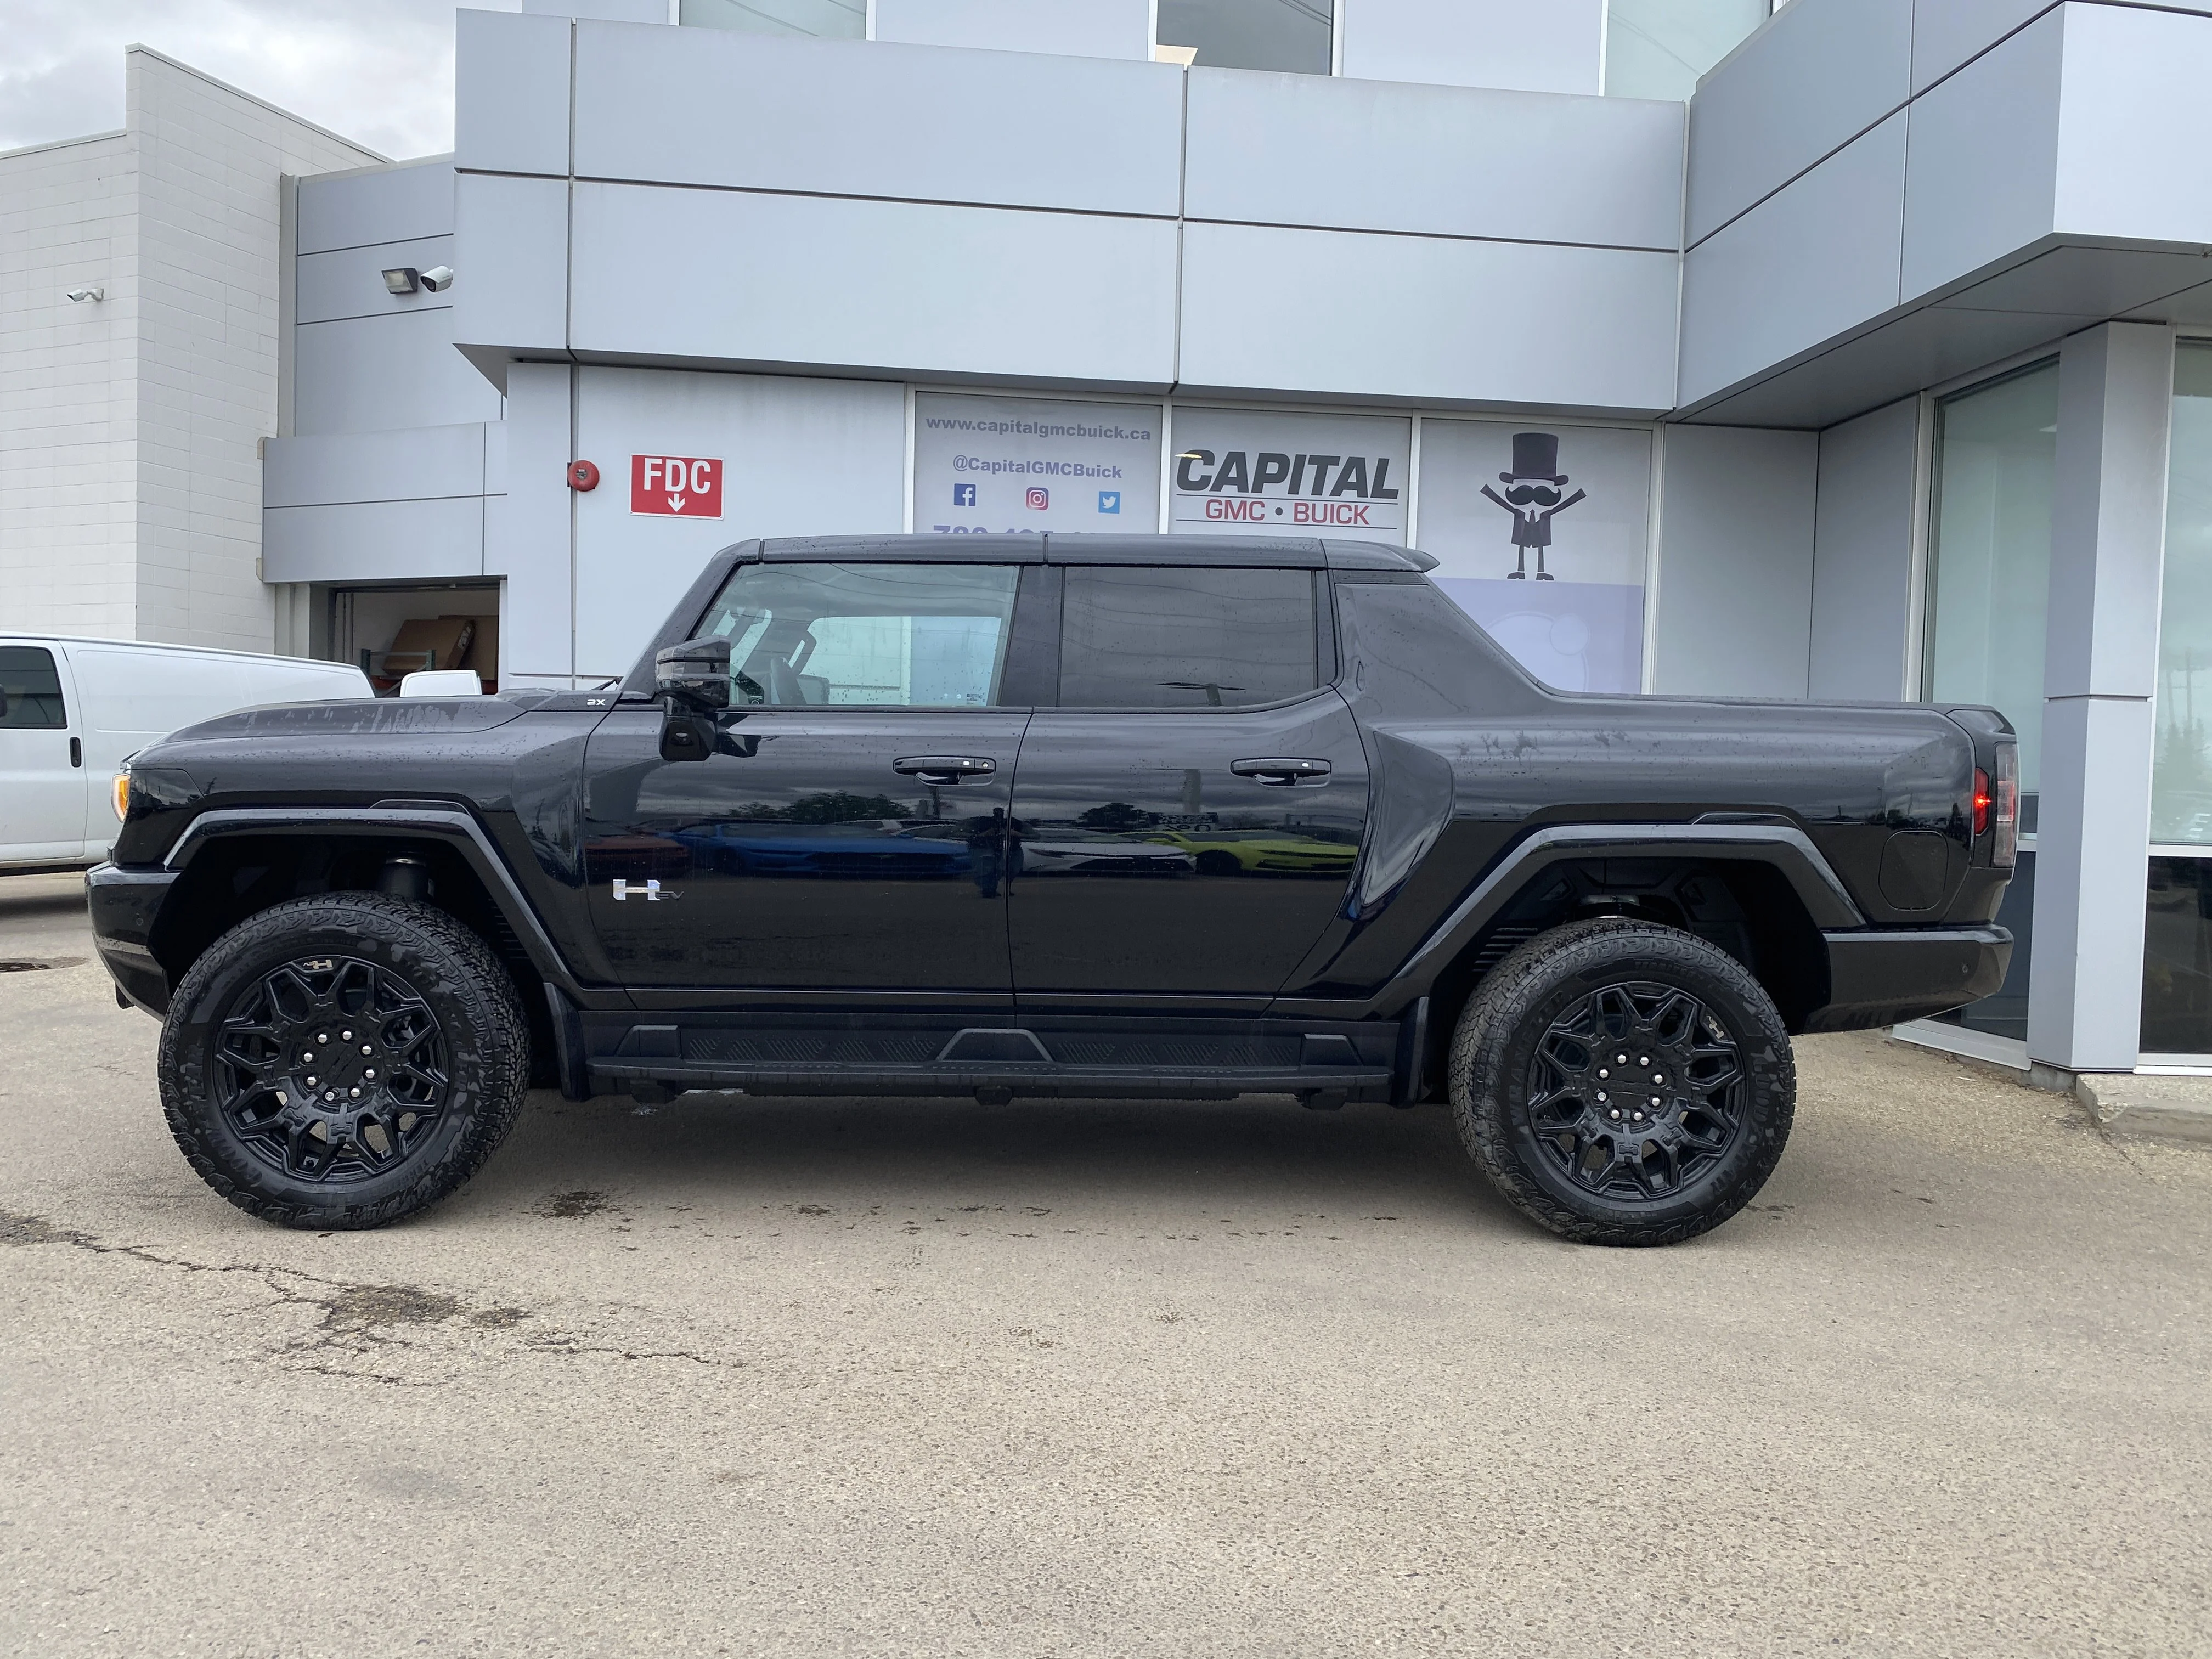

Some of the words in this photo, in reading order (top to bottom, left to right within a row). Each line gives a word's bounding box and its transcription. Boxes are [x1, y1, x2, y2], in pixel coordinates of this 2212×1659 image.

[926, 419, 1150, 441] www.capitalgmcbuick.ca
[644, 458, 711, 494] FDC
[953, 455, 1122, 478] @CapitalGMCBuick
[1177, 449, 1399, 499] CAPITAL
[1206, 499, 1265, 521] GMC
[1294, 503, 1370, 525] BUICK
